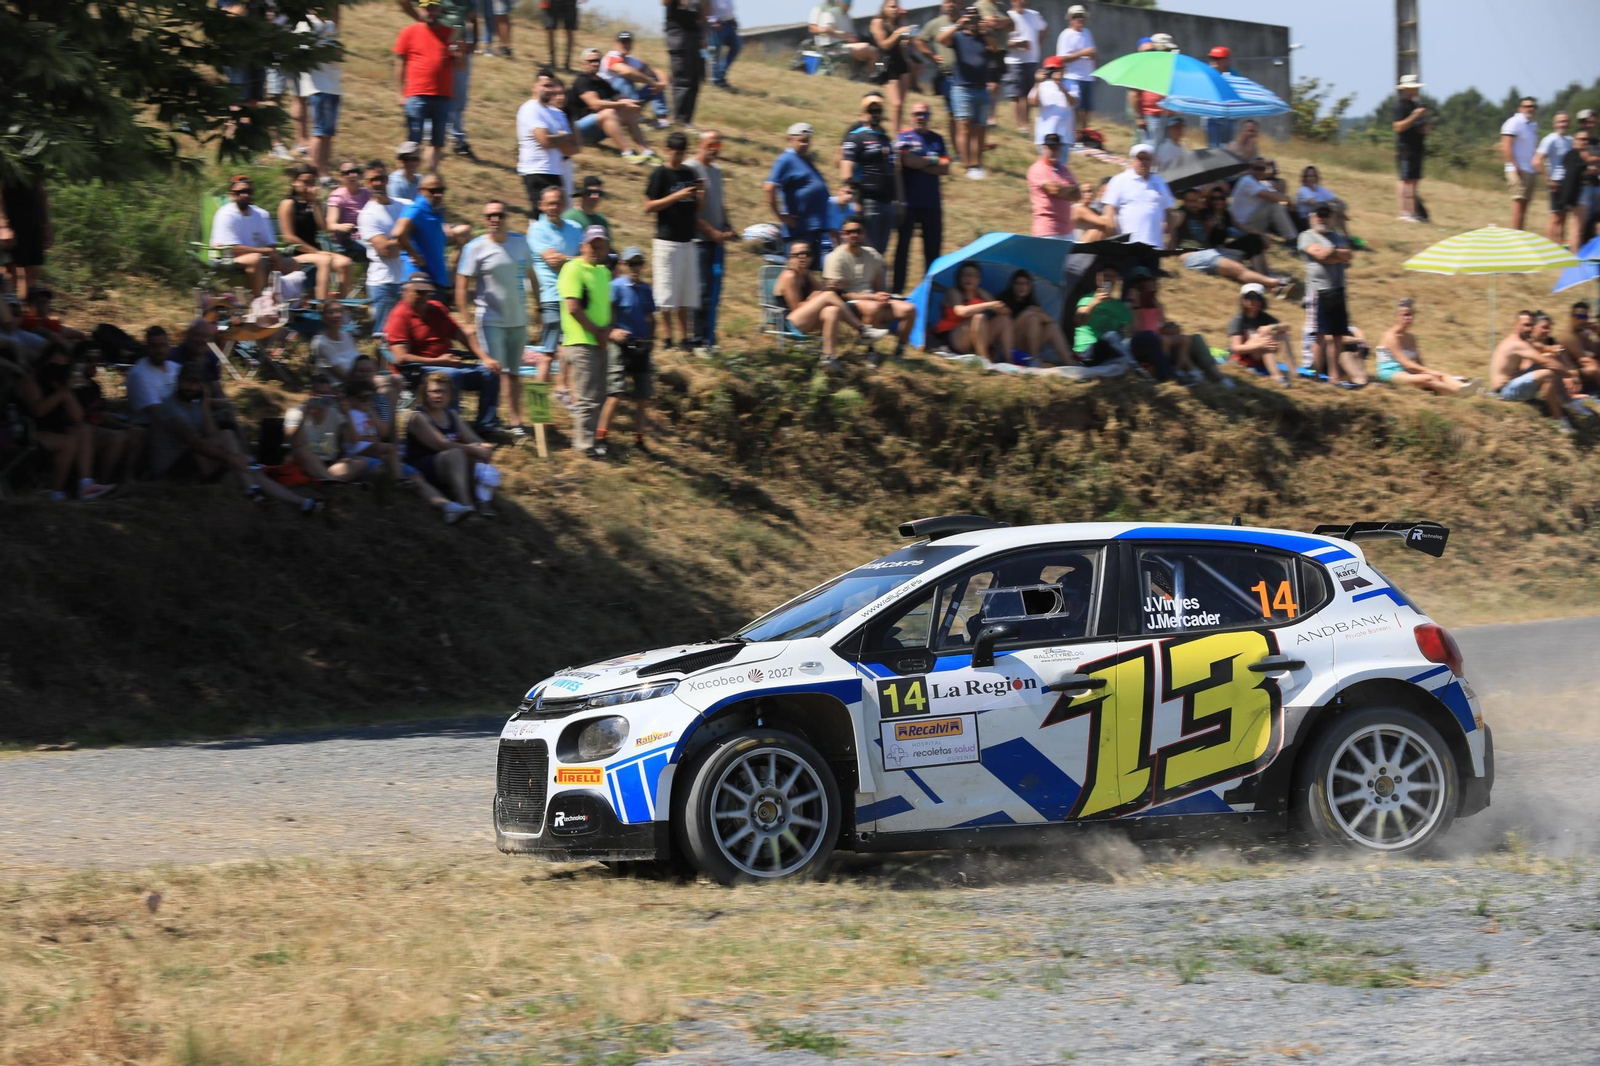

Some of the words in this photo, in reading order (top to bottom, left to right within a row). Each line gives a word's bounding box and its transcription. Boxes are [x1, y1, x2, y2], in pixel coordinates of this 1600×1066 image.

[1336, 568, 1356, 578] kars
[1143, 596, 1200, 614] J.Vinyes
[1251, 580, 1298, 618] 14
[1147, 611, 1220, 629] J.Mercader
[1297, 614, 1388, 645] ANDBANK
[1345, 631, 1367, 640] Private
[688, 675, 745, 692] Xacobeo
[768, 667, 794, 679] 2027
[932, 684, 961, 699] La
[964, 676, 1037, 697] Región
[883, 681, 926, 714] 14
[908, 722, 949, 736] Recalvi
[1048, 630, 1280, 819] 13
[911, 740, 942, 748] HOSPITAL
[912, 746, 952, 757] recoletas
[954, 743, 976, 754] salud
[558, 769, 601, 783] PIRELLI
